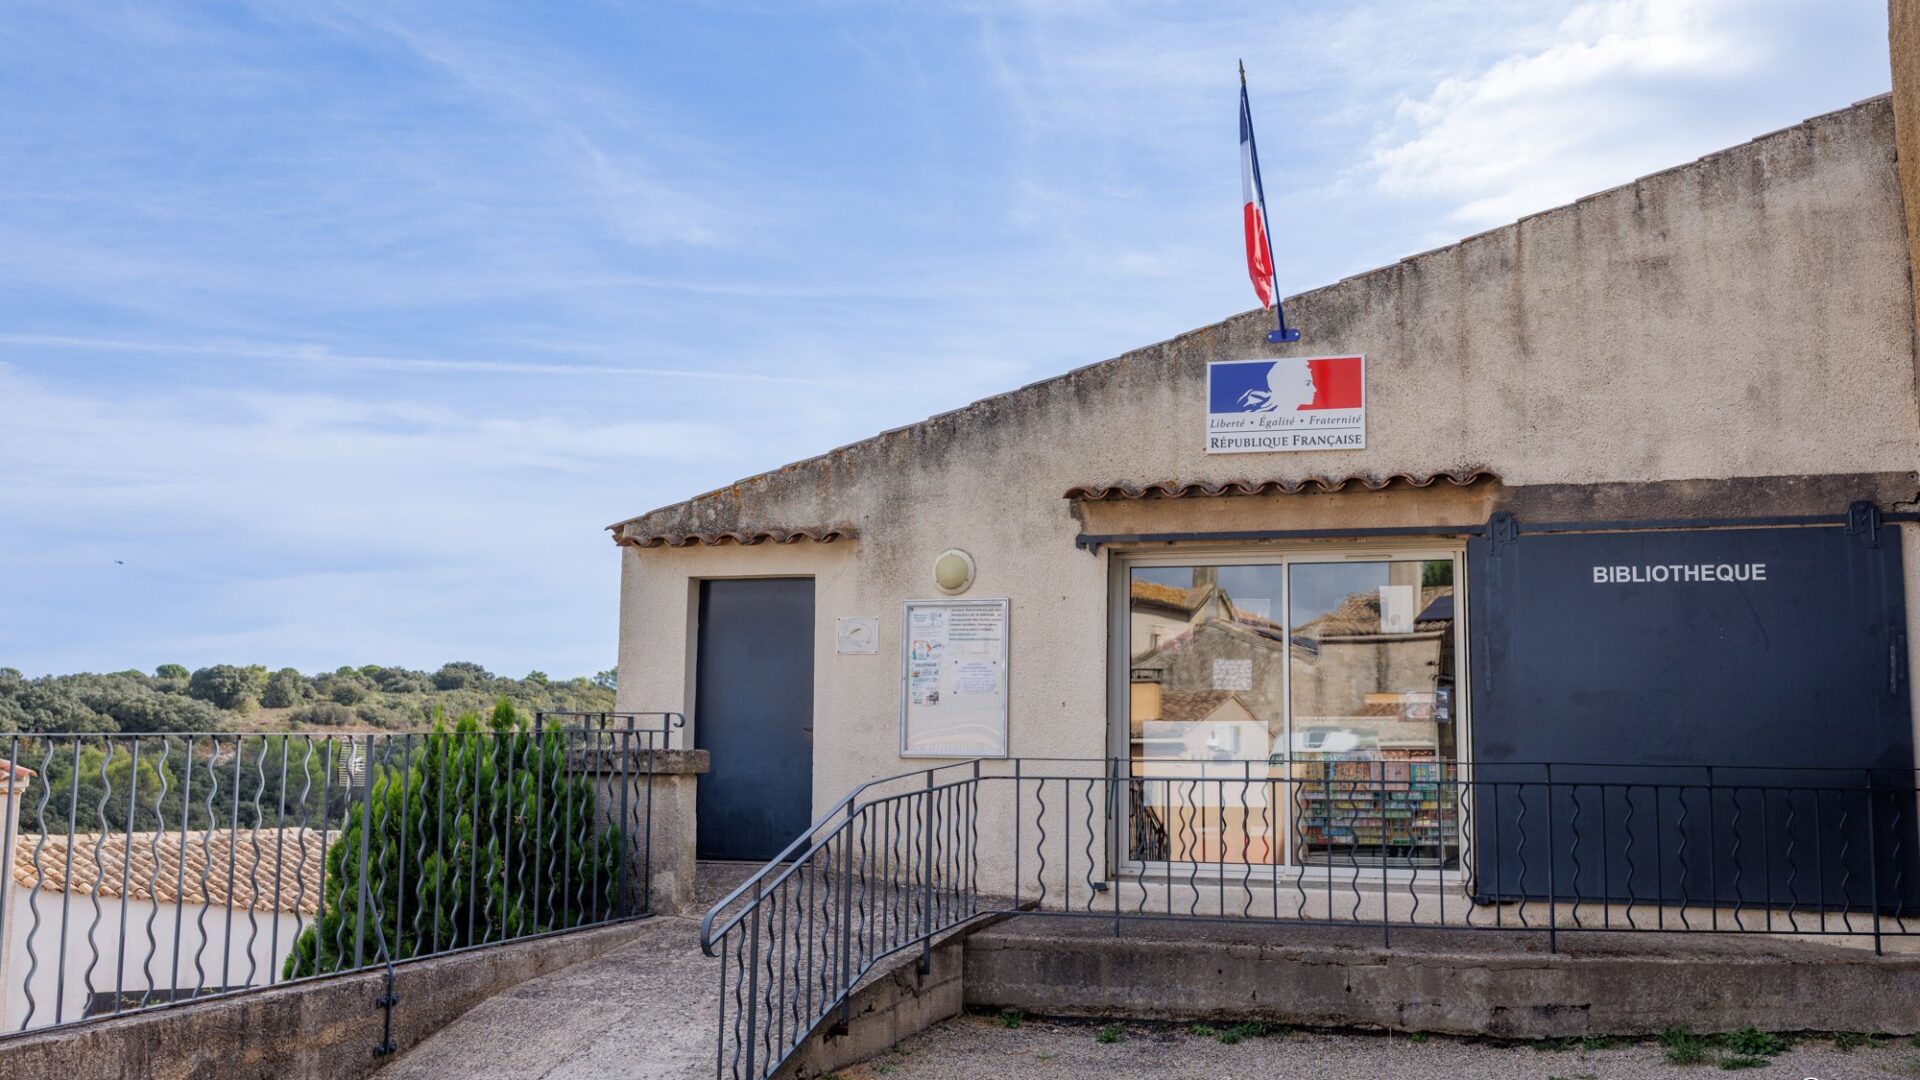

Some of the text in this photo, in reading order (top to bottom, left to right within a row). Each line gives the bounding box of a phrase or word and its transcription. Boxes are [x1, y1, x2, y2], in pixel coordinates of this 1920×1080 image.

[1210, 414, 1362, 429] Liberté Égalité Fraternité
[1210, 434, 1362, 449] RÉPUBLIQUE FRANÇAISE
[1593, 563, 1767, 583] BIBLIOTHEQUE
